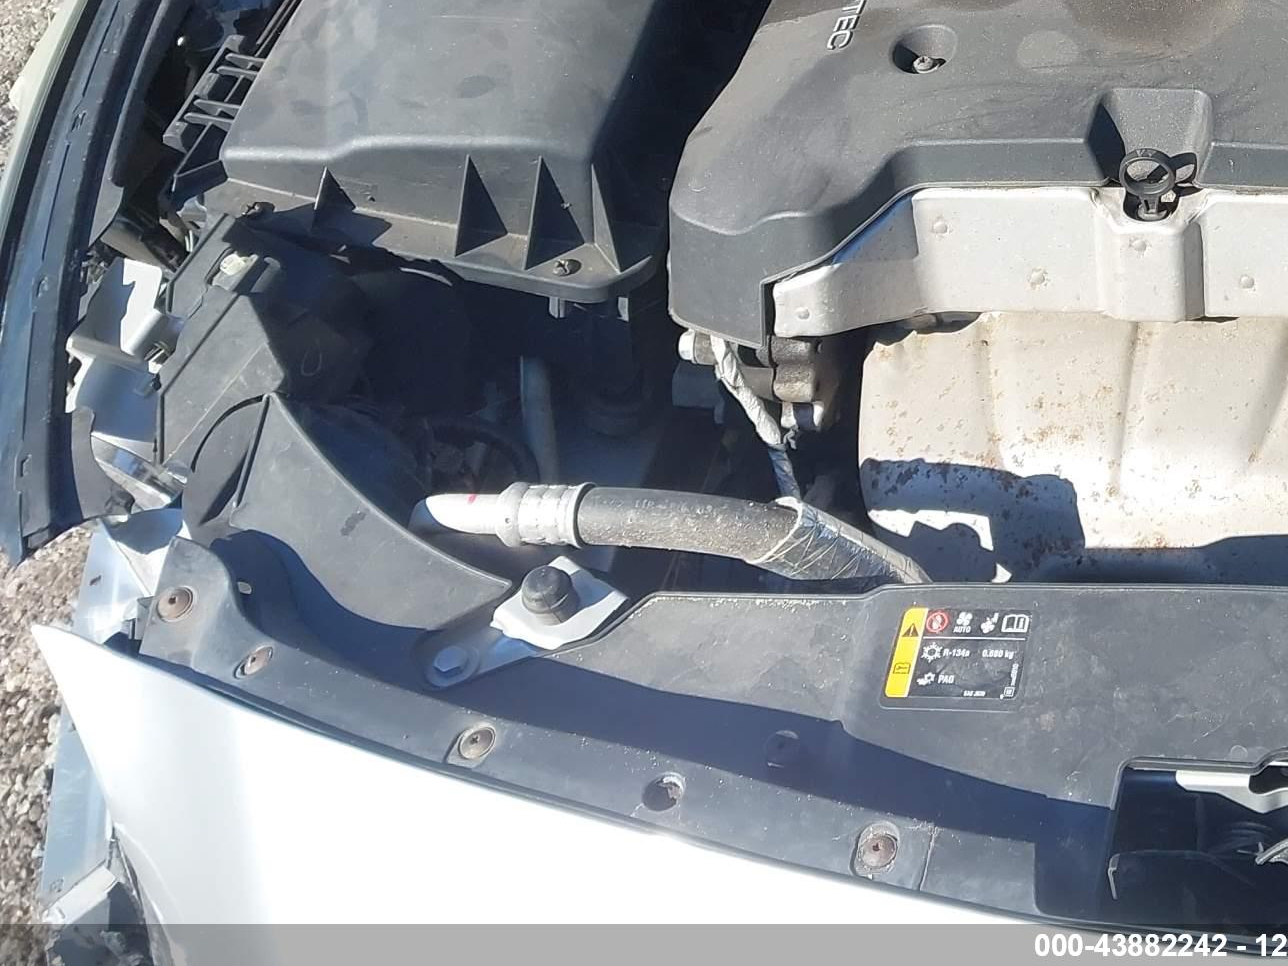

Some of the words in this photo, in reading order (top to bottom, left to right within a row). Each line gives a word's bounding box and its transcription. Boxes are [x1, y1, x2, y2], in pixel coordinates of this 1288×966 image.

[953, 626, 971, 634] AUTO
[943, 648, 971, 658] R-134a
[1004, 650, 1015, 660] kg
